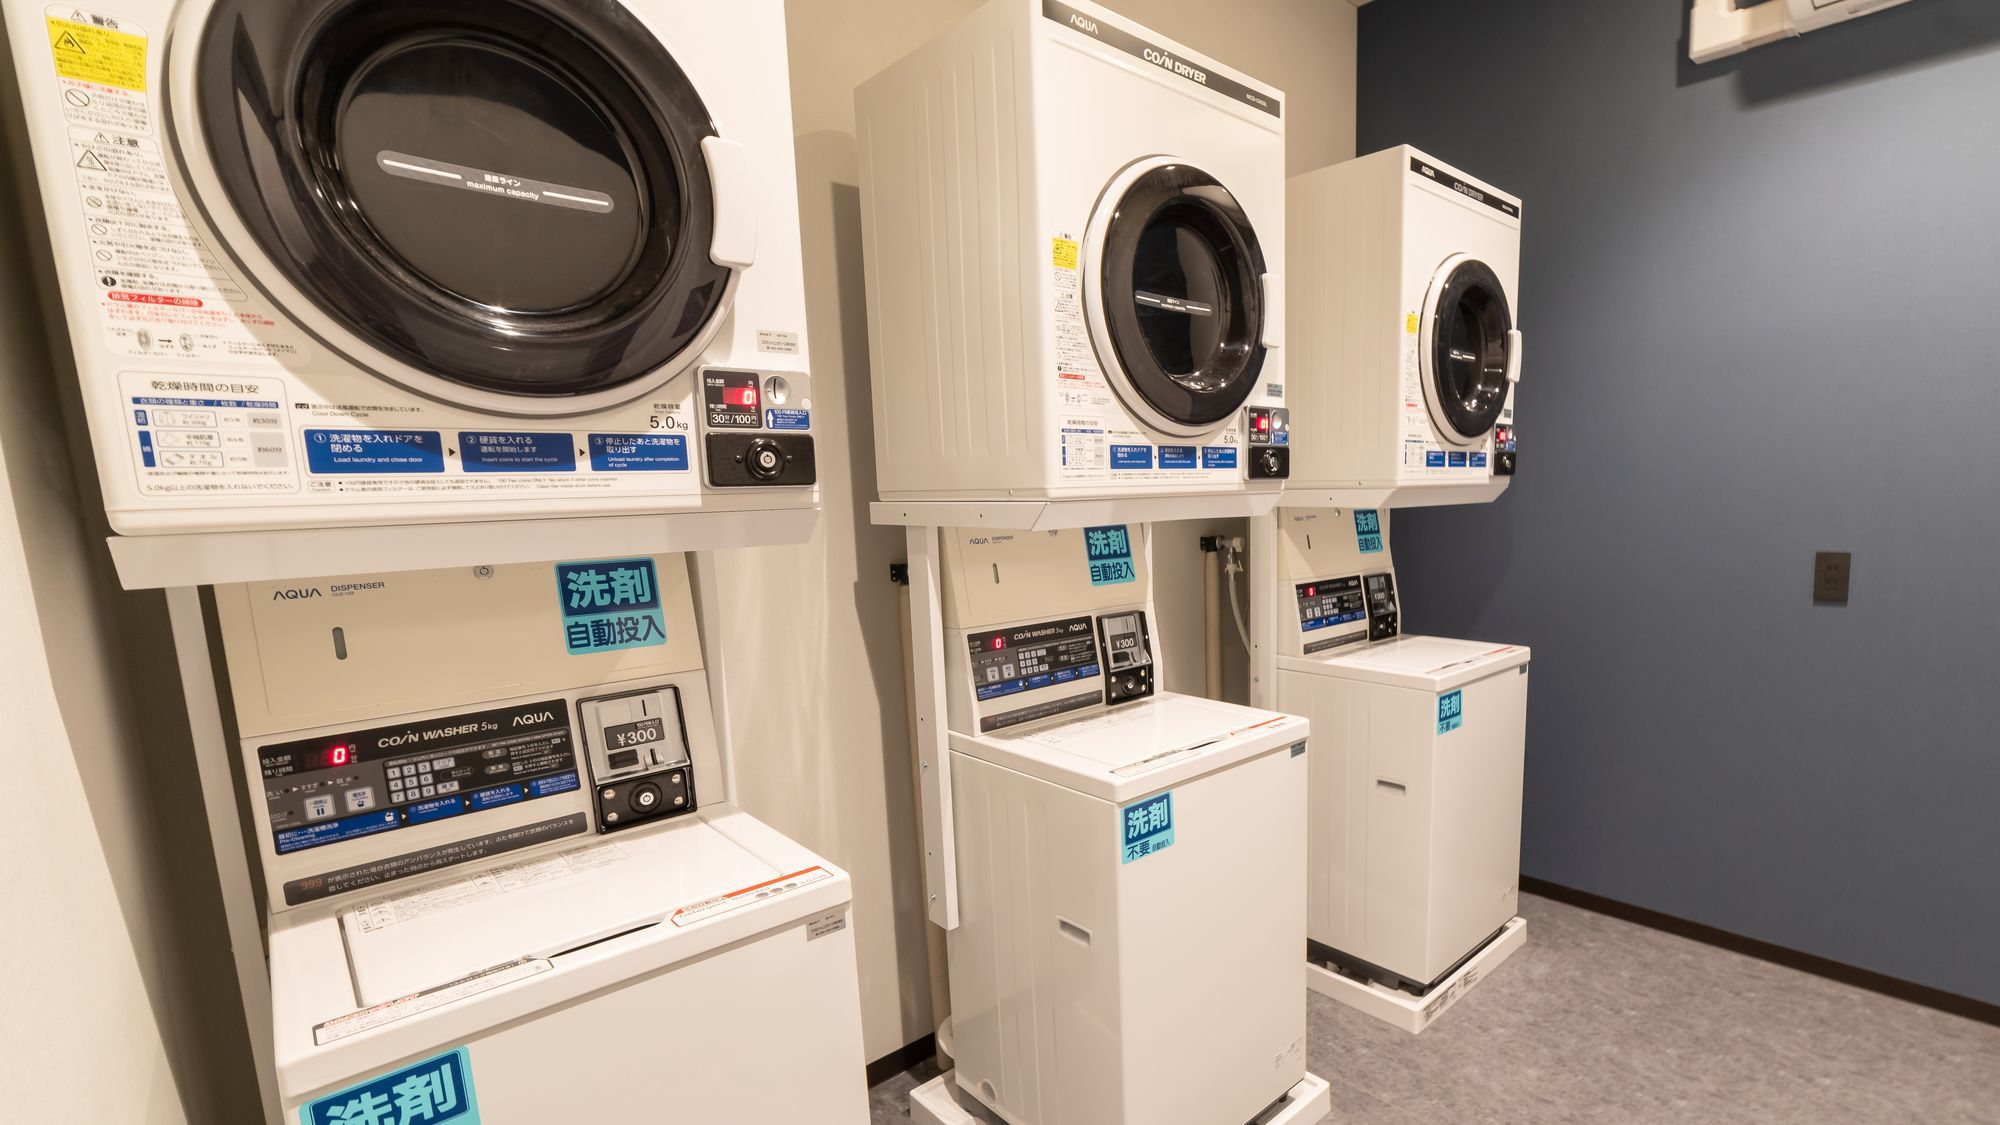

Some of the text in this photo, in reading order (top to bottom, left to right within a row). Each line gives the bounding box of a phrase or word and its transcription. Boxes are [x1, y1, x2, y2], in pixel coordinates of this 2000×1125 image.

[1070, 13, 1098, 35] AQUA
[1143, 49, 1206, 85] COIN DRYER
[484, 173, 521, 187] ライン
[466, 181, 539, 201] maximum capacity
[151, 380, 260, 394] 乾燥時間の目安
[329, 433, 424, 444] 洗濯物を入れドアを
[479, 435, 533, 445] 硬貨を入れる
[605, 438, 680, 446] 停止したあと洗濯物を
[331, 444, 364, 453] 閉める
[606, 446, 637, 454] 取り出す
[352, 456, 376, 464] laundry
[1356, 512, 1378, 532] 洗剤
[969, 537, 990, 545] AQUA
[1088, 529, 1128, 556] 洗剤
[1360, 536, 1383, 551] 自動投入
[1090, 562, 1135, 582] 自動投入
[273, 581, 385, 601] AQUA DISPENSER
[566, 566, 652, 609] 洗剤
[566, 615, 666, 649] 自動投入
[1014, 630, 1031, 641] COIN
[1031, 628, 1055, 638] WASHER
[1069, 623, 1088, 632] AQUA
[995, 638, 1002, 649] 0
[1440, 692, 1460, 719] 洗剤
[377, 711, 554, 748] COIN WASHER 5kg AQUA
[616, 728, 657, 747] ¥300
[333, 747, 346, 764] 0
[264, 766, 294, 776] 残り時間
[417, 798, 456, 811] 洗濯物を入れる
[1127, 798, 1169, 839] 洗剤
[1127, 840, 1150, 860] 不要
[300, 878, 322, 889] 999
[326, 1062, 458, 1125] 洗剤
